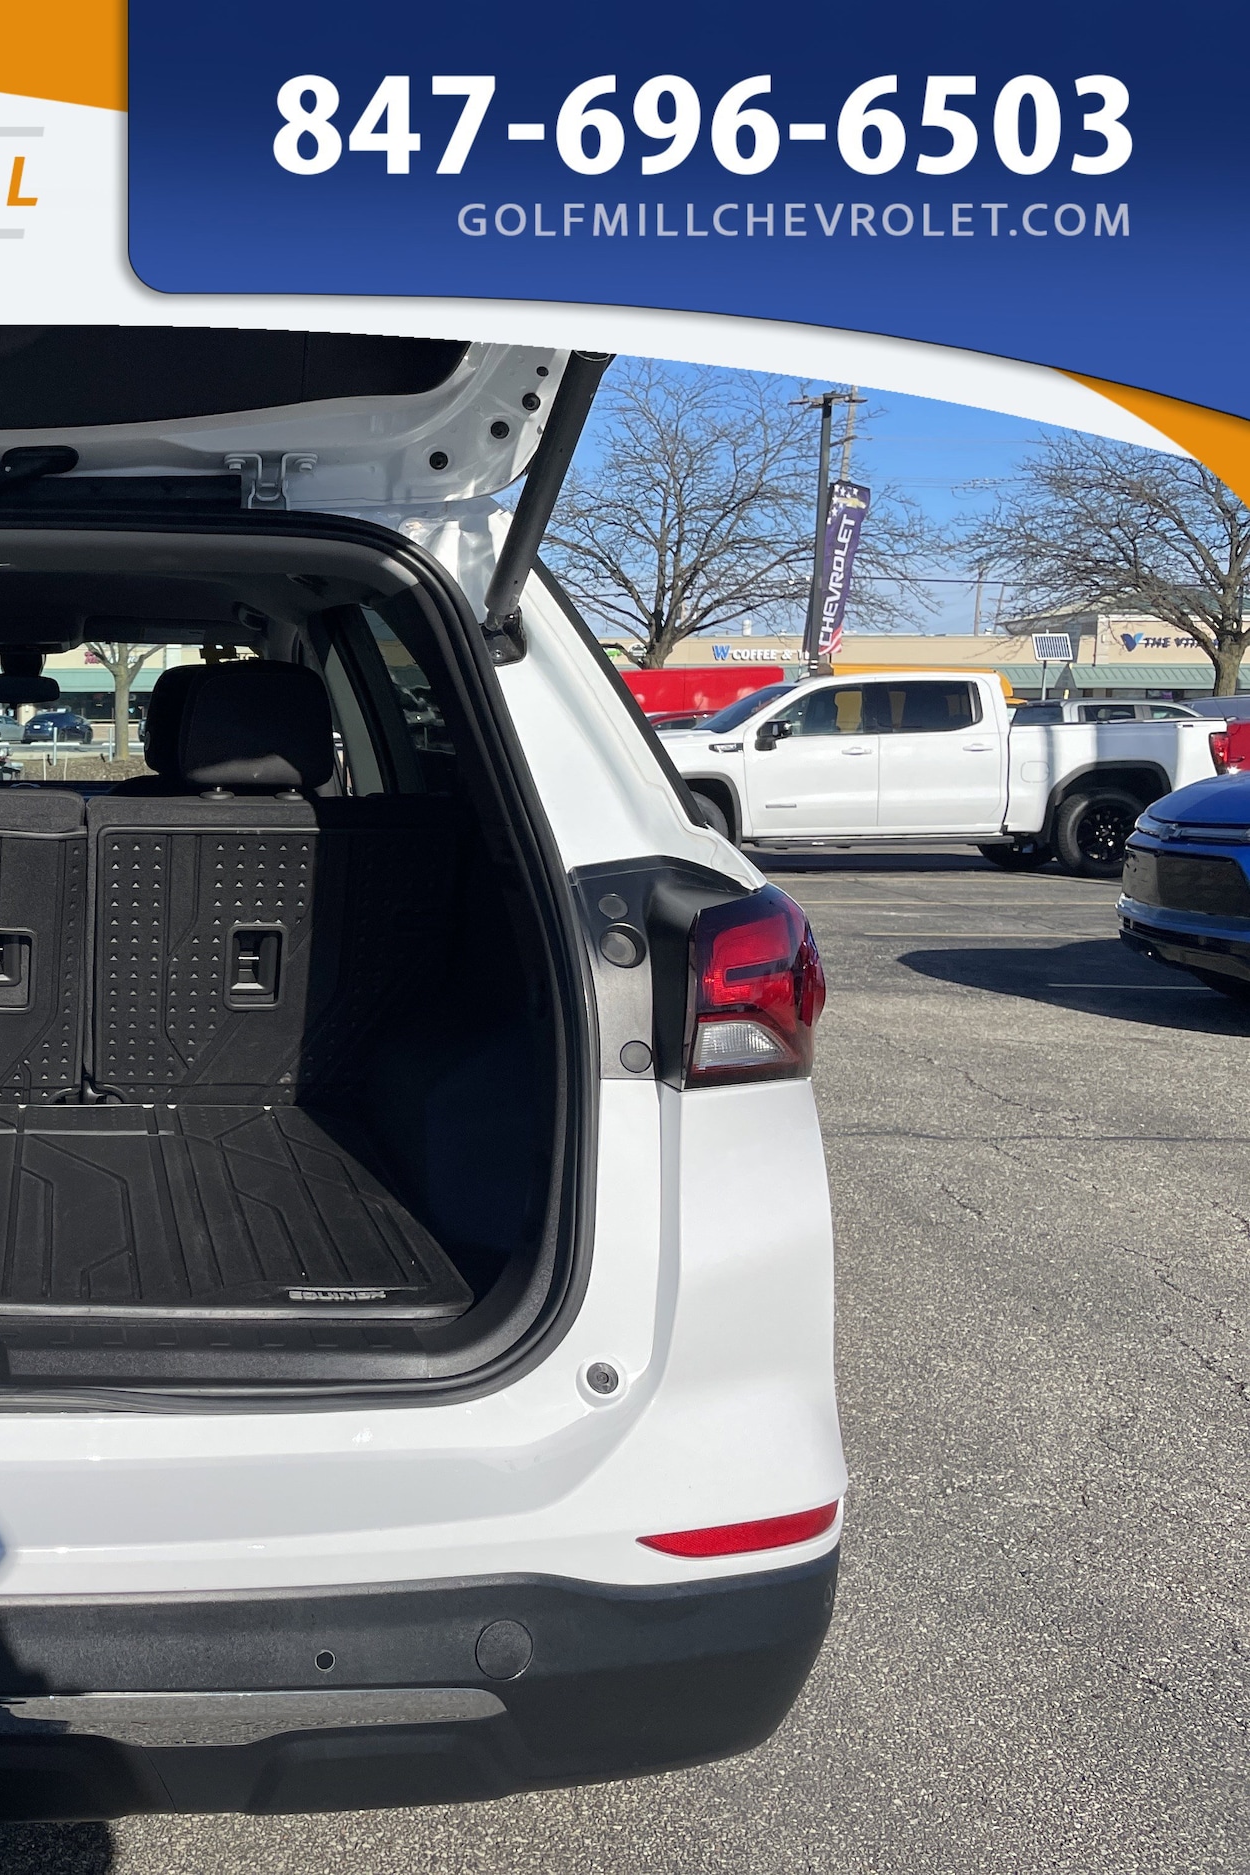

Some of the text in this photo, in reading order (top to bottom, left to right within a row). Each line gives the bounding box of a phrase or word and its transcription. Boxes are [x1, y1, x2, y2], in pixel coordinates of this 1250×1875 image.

[819, 514, 856, 647] CHEVROLET
[732, 649, 777, 660] COFFEE
[782, 649, 793, 660] &
